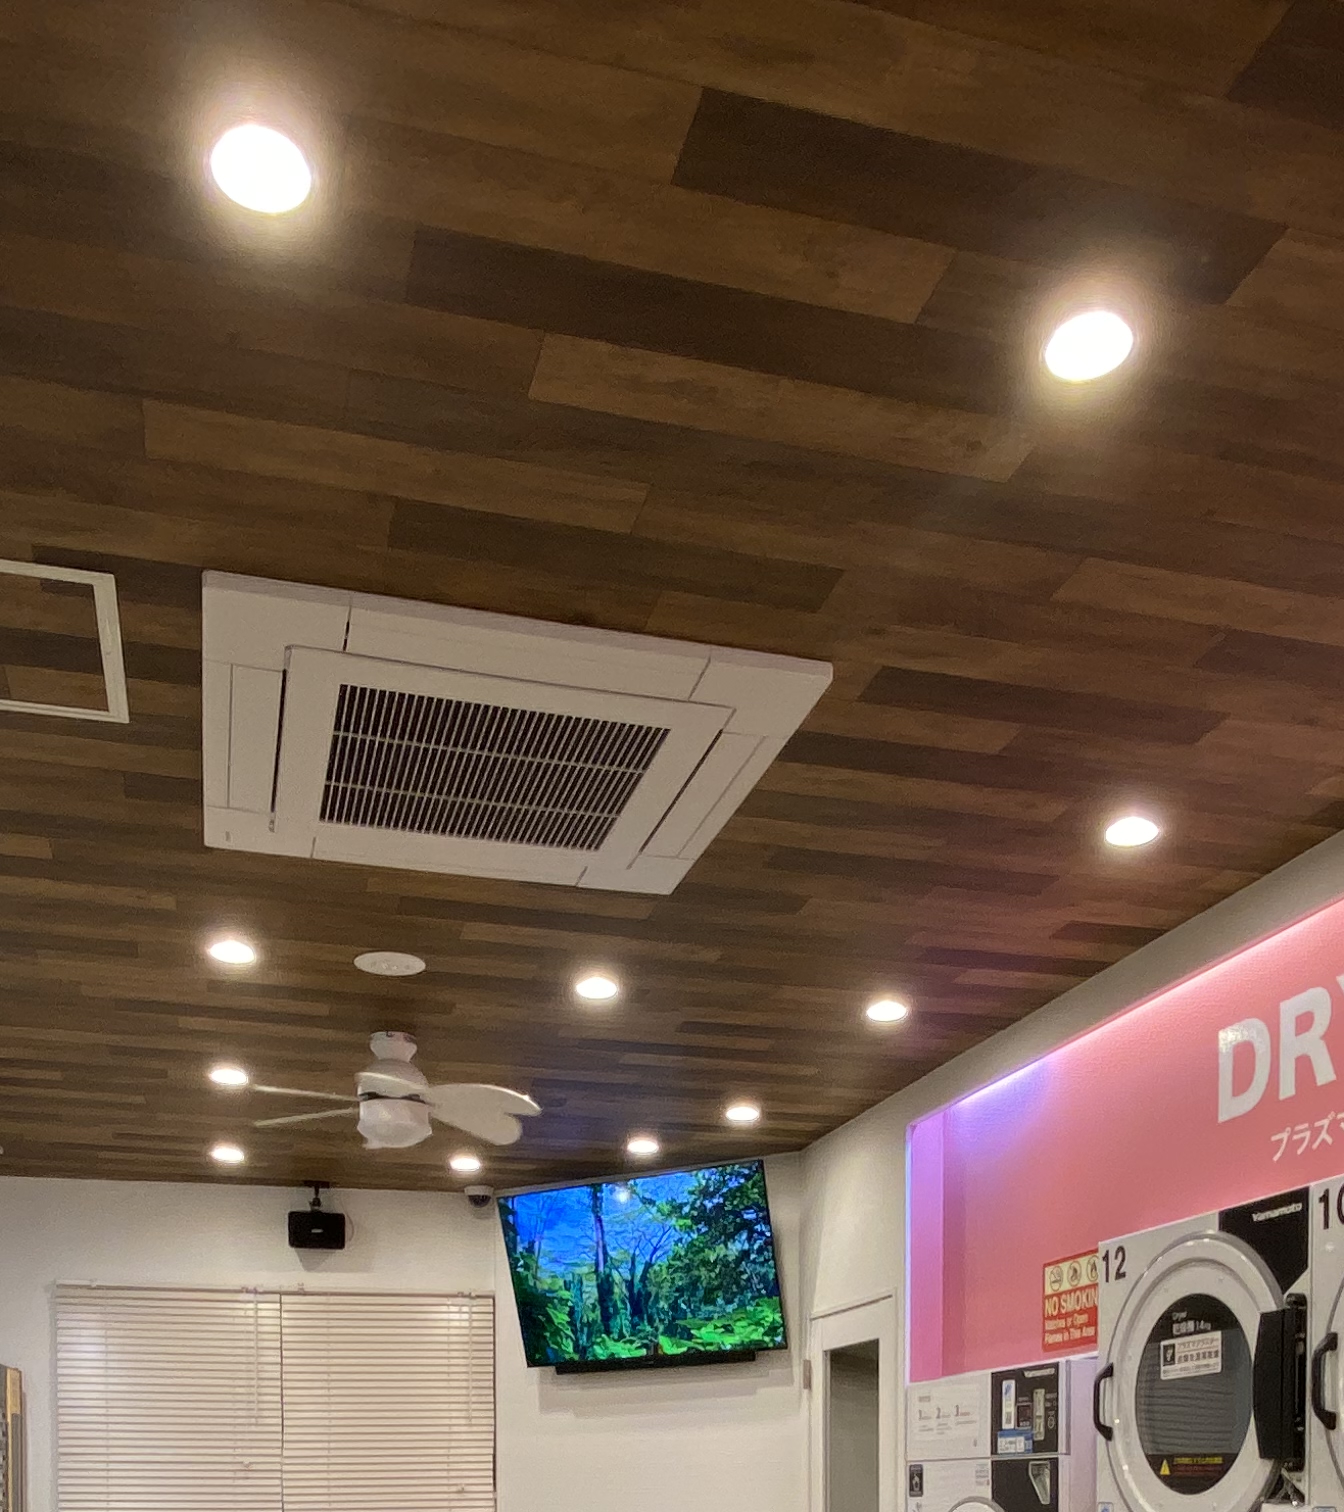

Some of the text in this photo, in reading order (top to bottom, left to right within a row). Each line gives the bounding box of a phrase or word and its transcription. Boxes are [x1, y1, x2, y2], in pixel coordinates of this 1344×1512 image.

[1102, 1245, 1127, 1283] 12
[1044, 1287, 1098, 1318] NO SMOKIN
